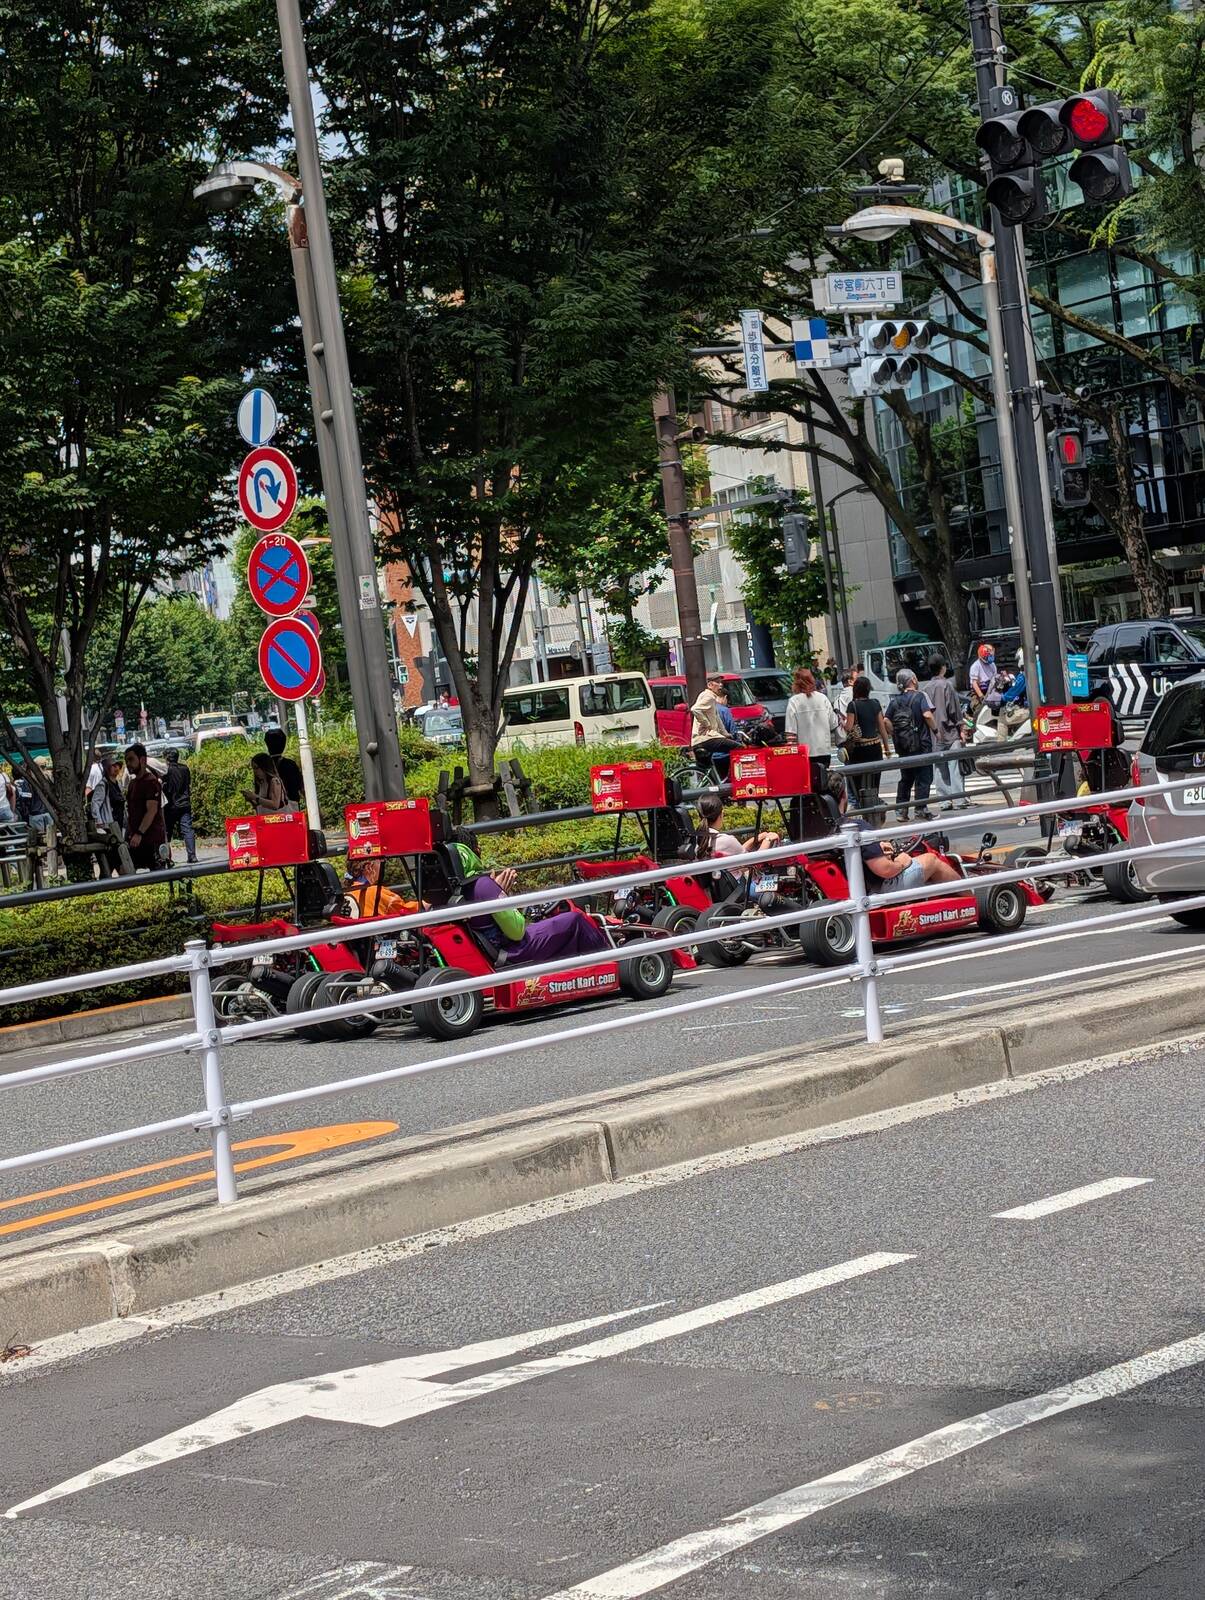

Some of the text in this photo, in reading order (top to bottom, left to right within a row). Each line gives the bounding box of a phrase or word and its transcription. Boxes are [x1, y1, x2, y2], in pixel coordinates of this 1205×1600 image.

[262, 536, 286, 549] 7-20
[1153, 677, 1180, 697] Ub
[919, 912, 942, 925] Street
[943, 909, 959, 921] Kart
[549, 974, 616, 993] Street Kart .com
